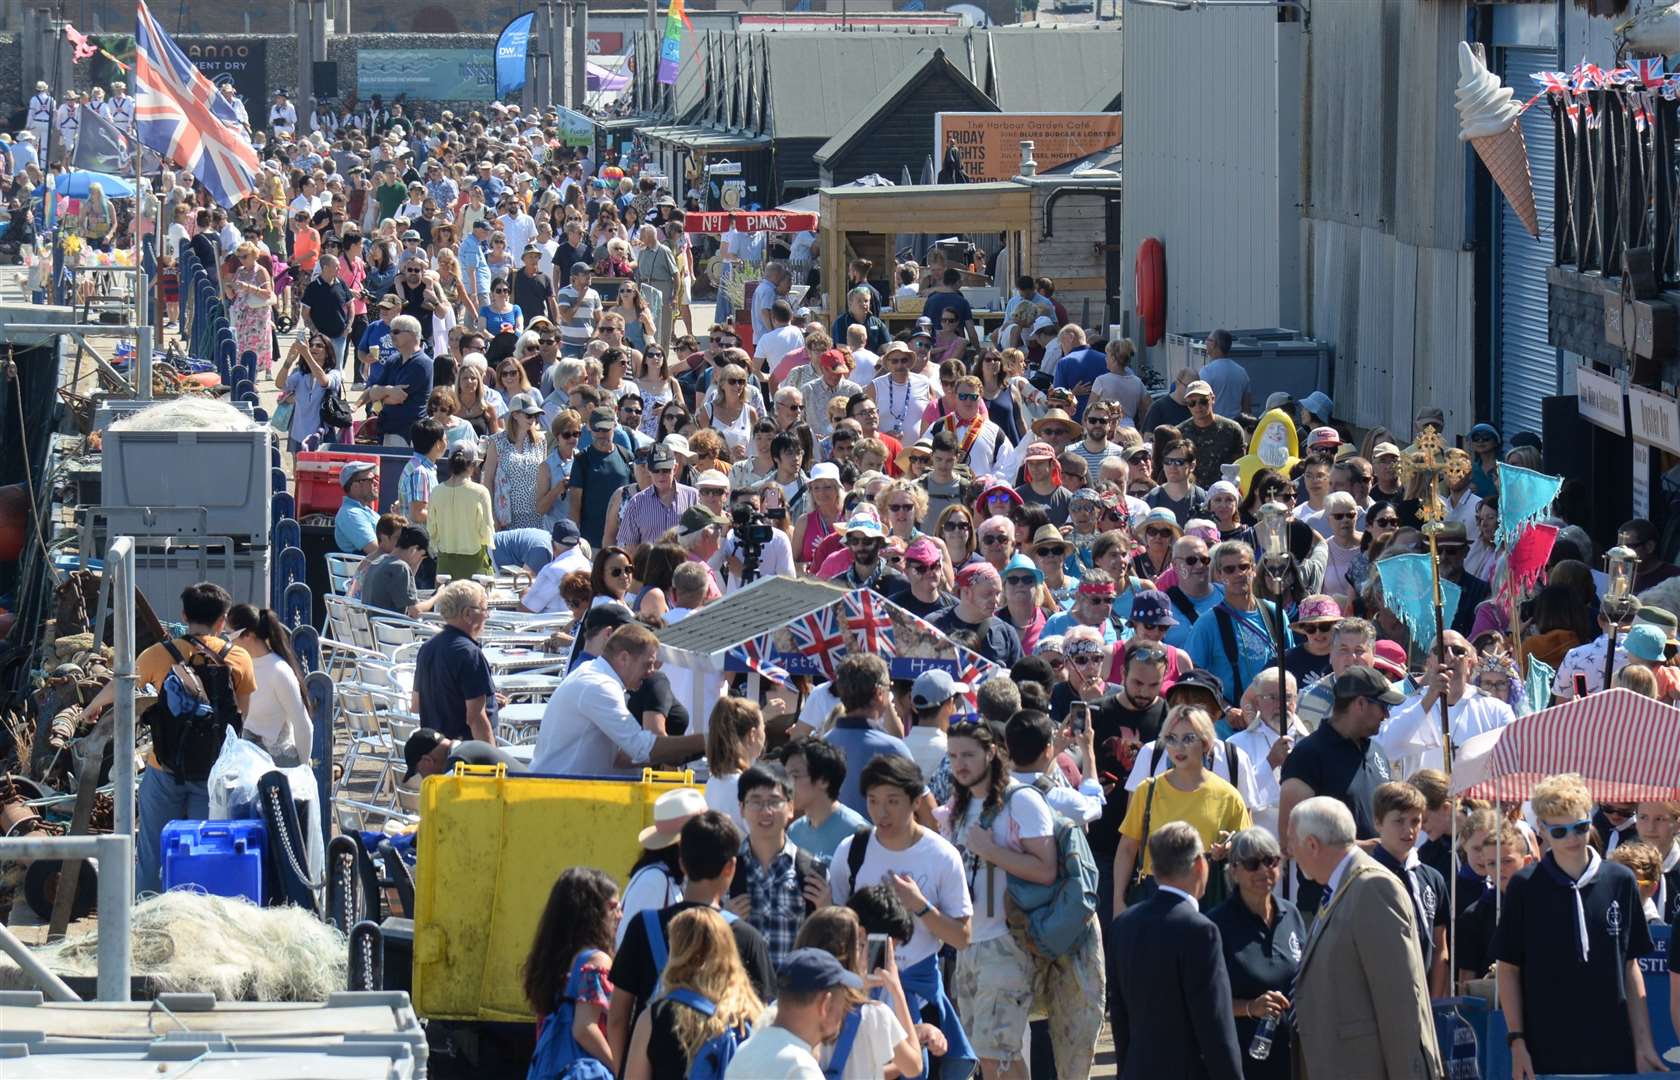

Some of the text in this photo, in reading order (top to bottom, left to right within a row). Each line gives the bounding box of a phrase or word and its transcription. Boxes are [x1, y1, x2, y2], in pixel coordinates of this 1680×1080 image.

[224, 61, 248, 71] DRY
[968, 120, 984, 129] The
[987, 120, 1025, 129] Harbour
[1027, 120, 1064, 129] Garden
[946, 130, 985, 145] FRIDAY
[956, 145, 985, 160] GHTS
[746, 215, 787, 231] PIMM'S
